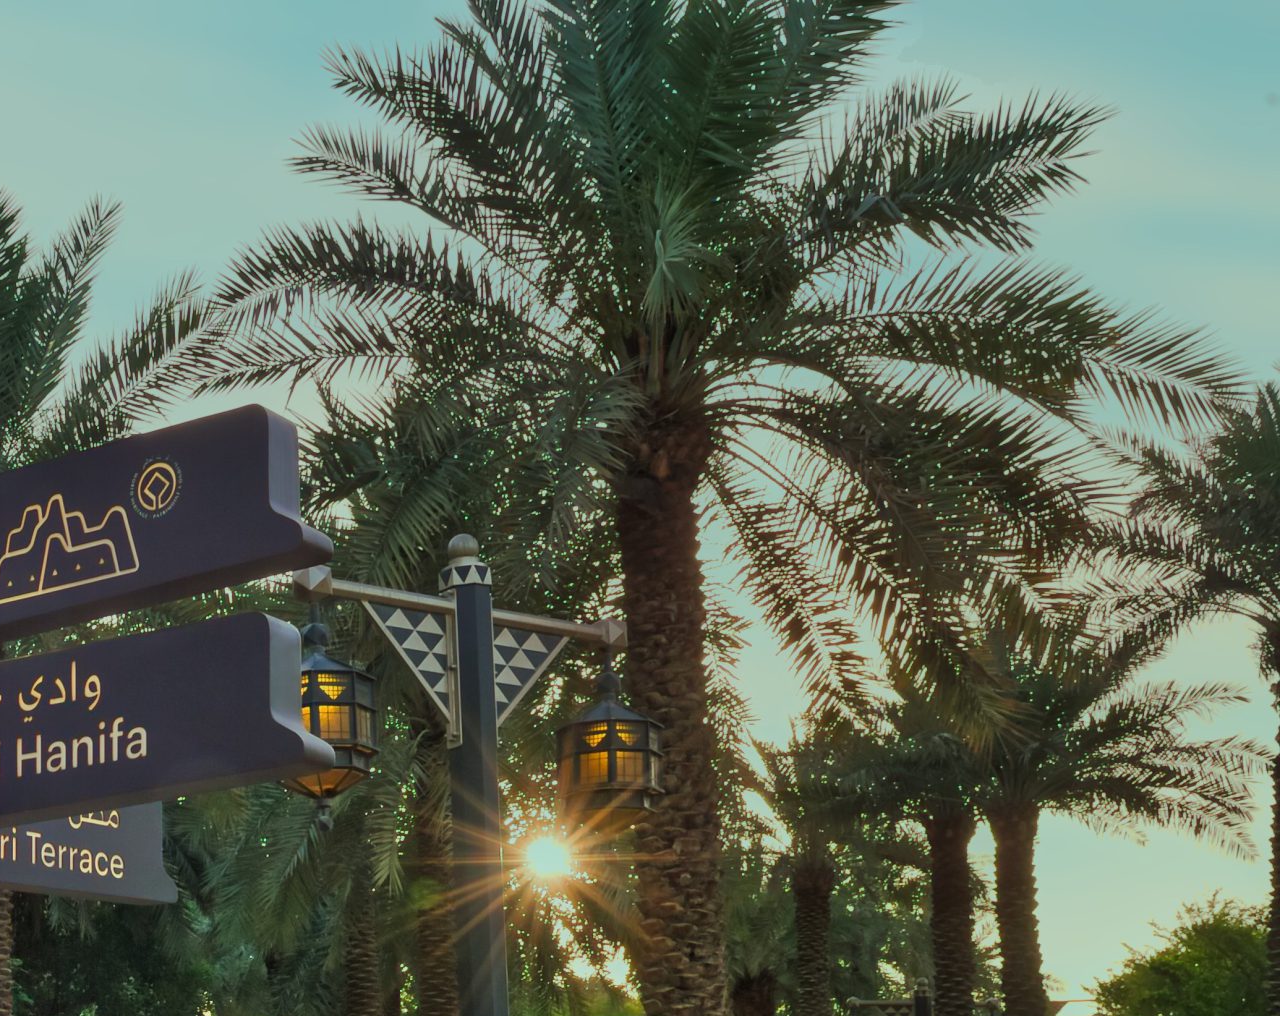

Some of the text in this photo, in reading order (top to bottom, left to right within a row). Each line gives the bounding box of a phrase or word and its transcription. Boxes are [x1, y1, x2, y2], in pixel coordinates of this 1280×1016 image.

[18, 661, 101, 723] وادي
[16, 717, 148, 777] Hanifa
[26, 831, 124, 879] Terrace
